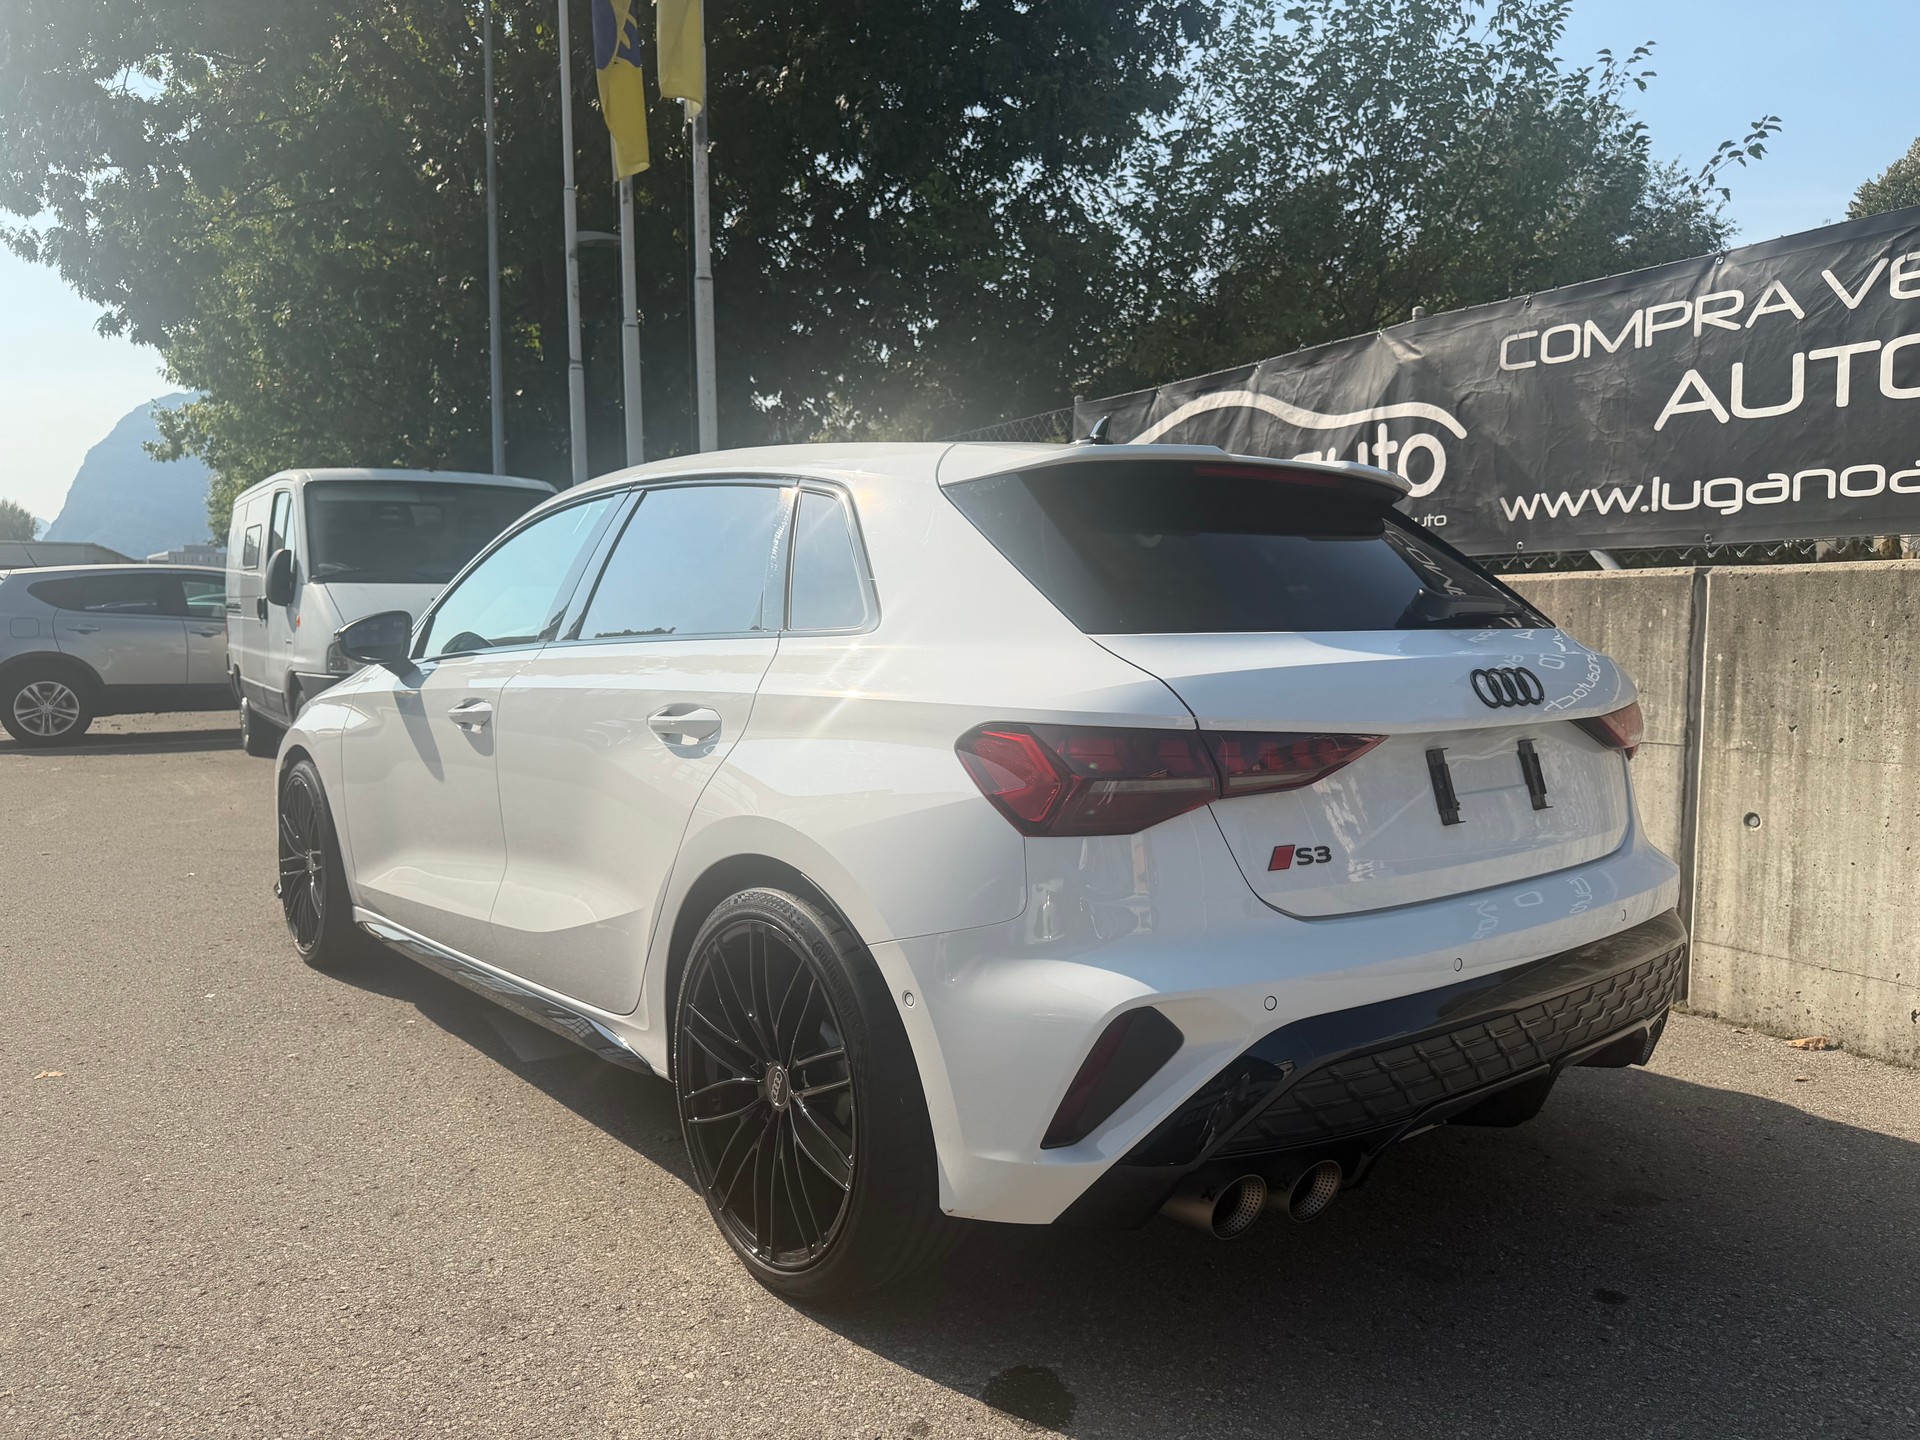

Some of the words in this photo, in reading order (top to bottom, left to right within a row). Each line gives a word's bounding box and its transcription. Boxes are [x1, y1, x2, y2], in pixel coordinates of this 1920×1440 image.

[1500, 279, 1805, 371] COMPRA
[1410, 513, 1447, 527] uto
[1295, 845, 1332, 866] S3
